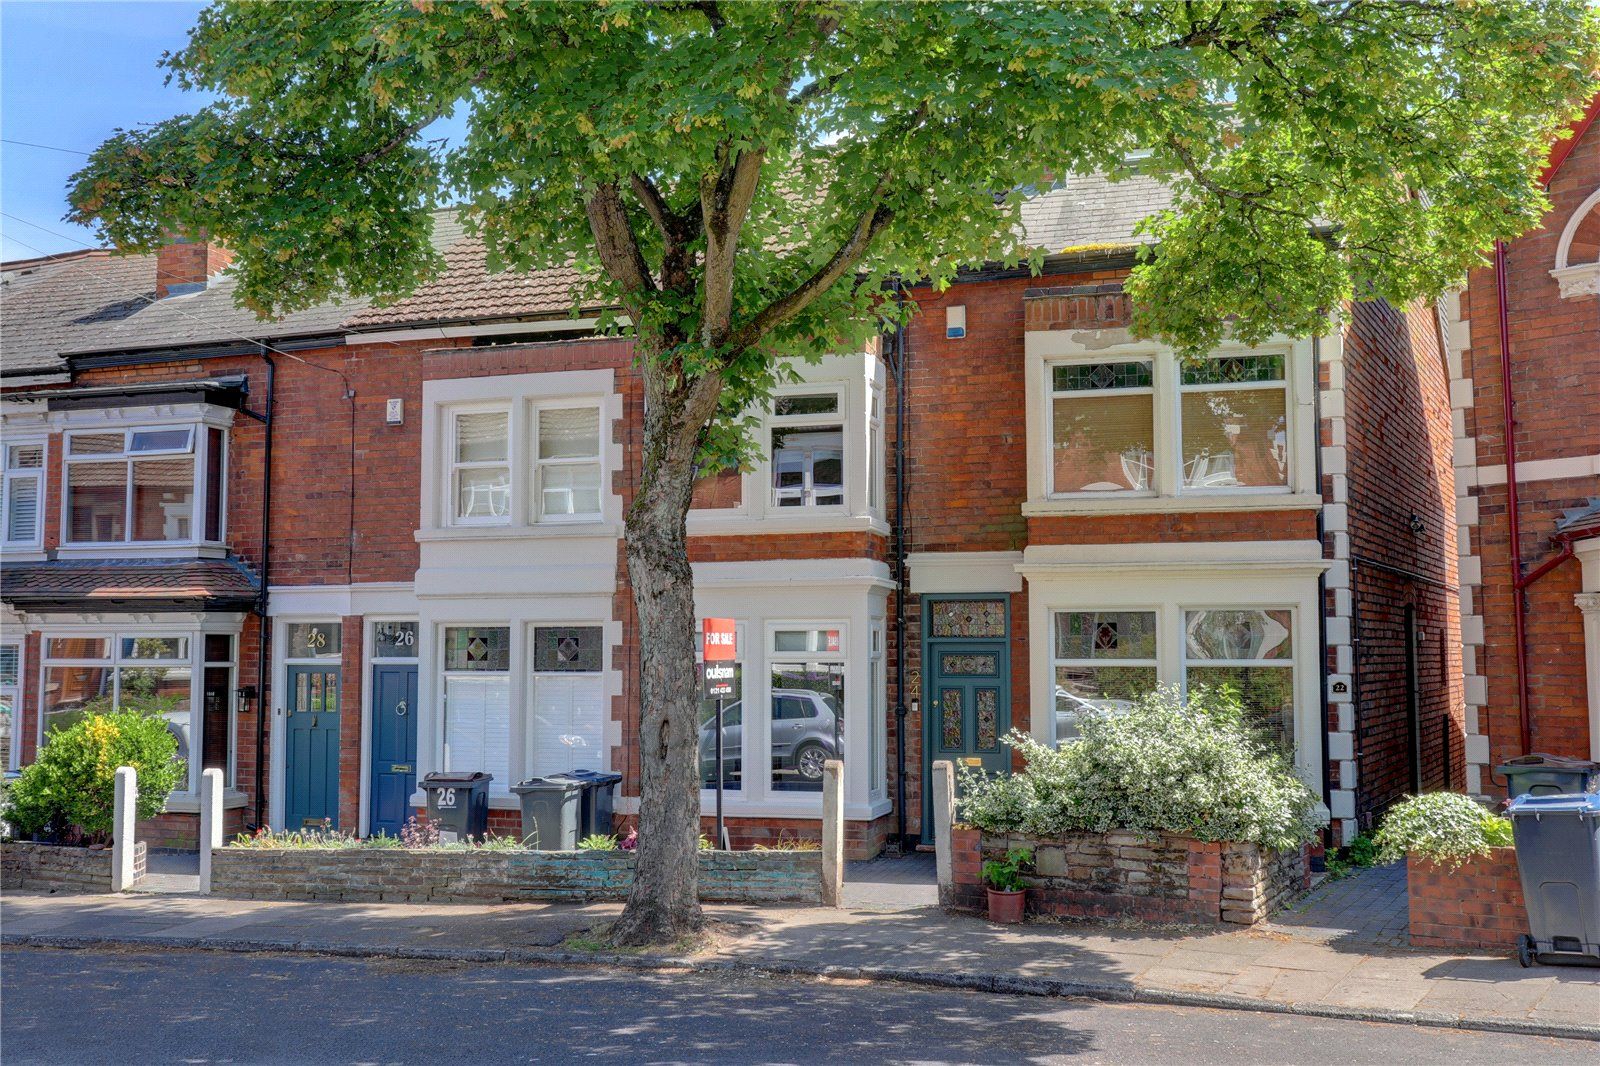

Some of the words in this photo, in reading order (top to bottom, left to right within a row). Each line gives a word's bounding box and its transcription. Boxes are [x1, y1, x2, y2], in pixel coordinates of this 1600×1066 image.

[307, 633, 326, 648] 28
[395, 630, 414, 646] 26
[705, 632, 719, 645] FOR
[720, 632, 733, 645] SALE
[910, 670, 919, 698] 24
[437, 787, 456, 806] 26
